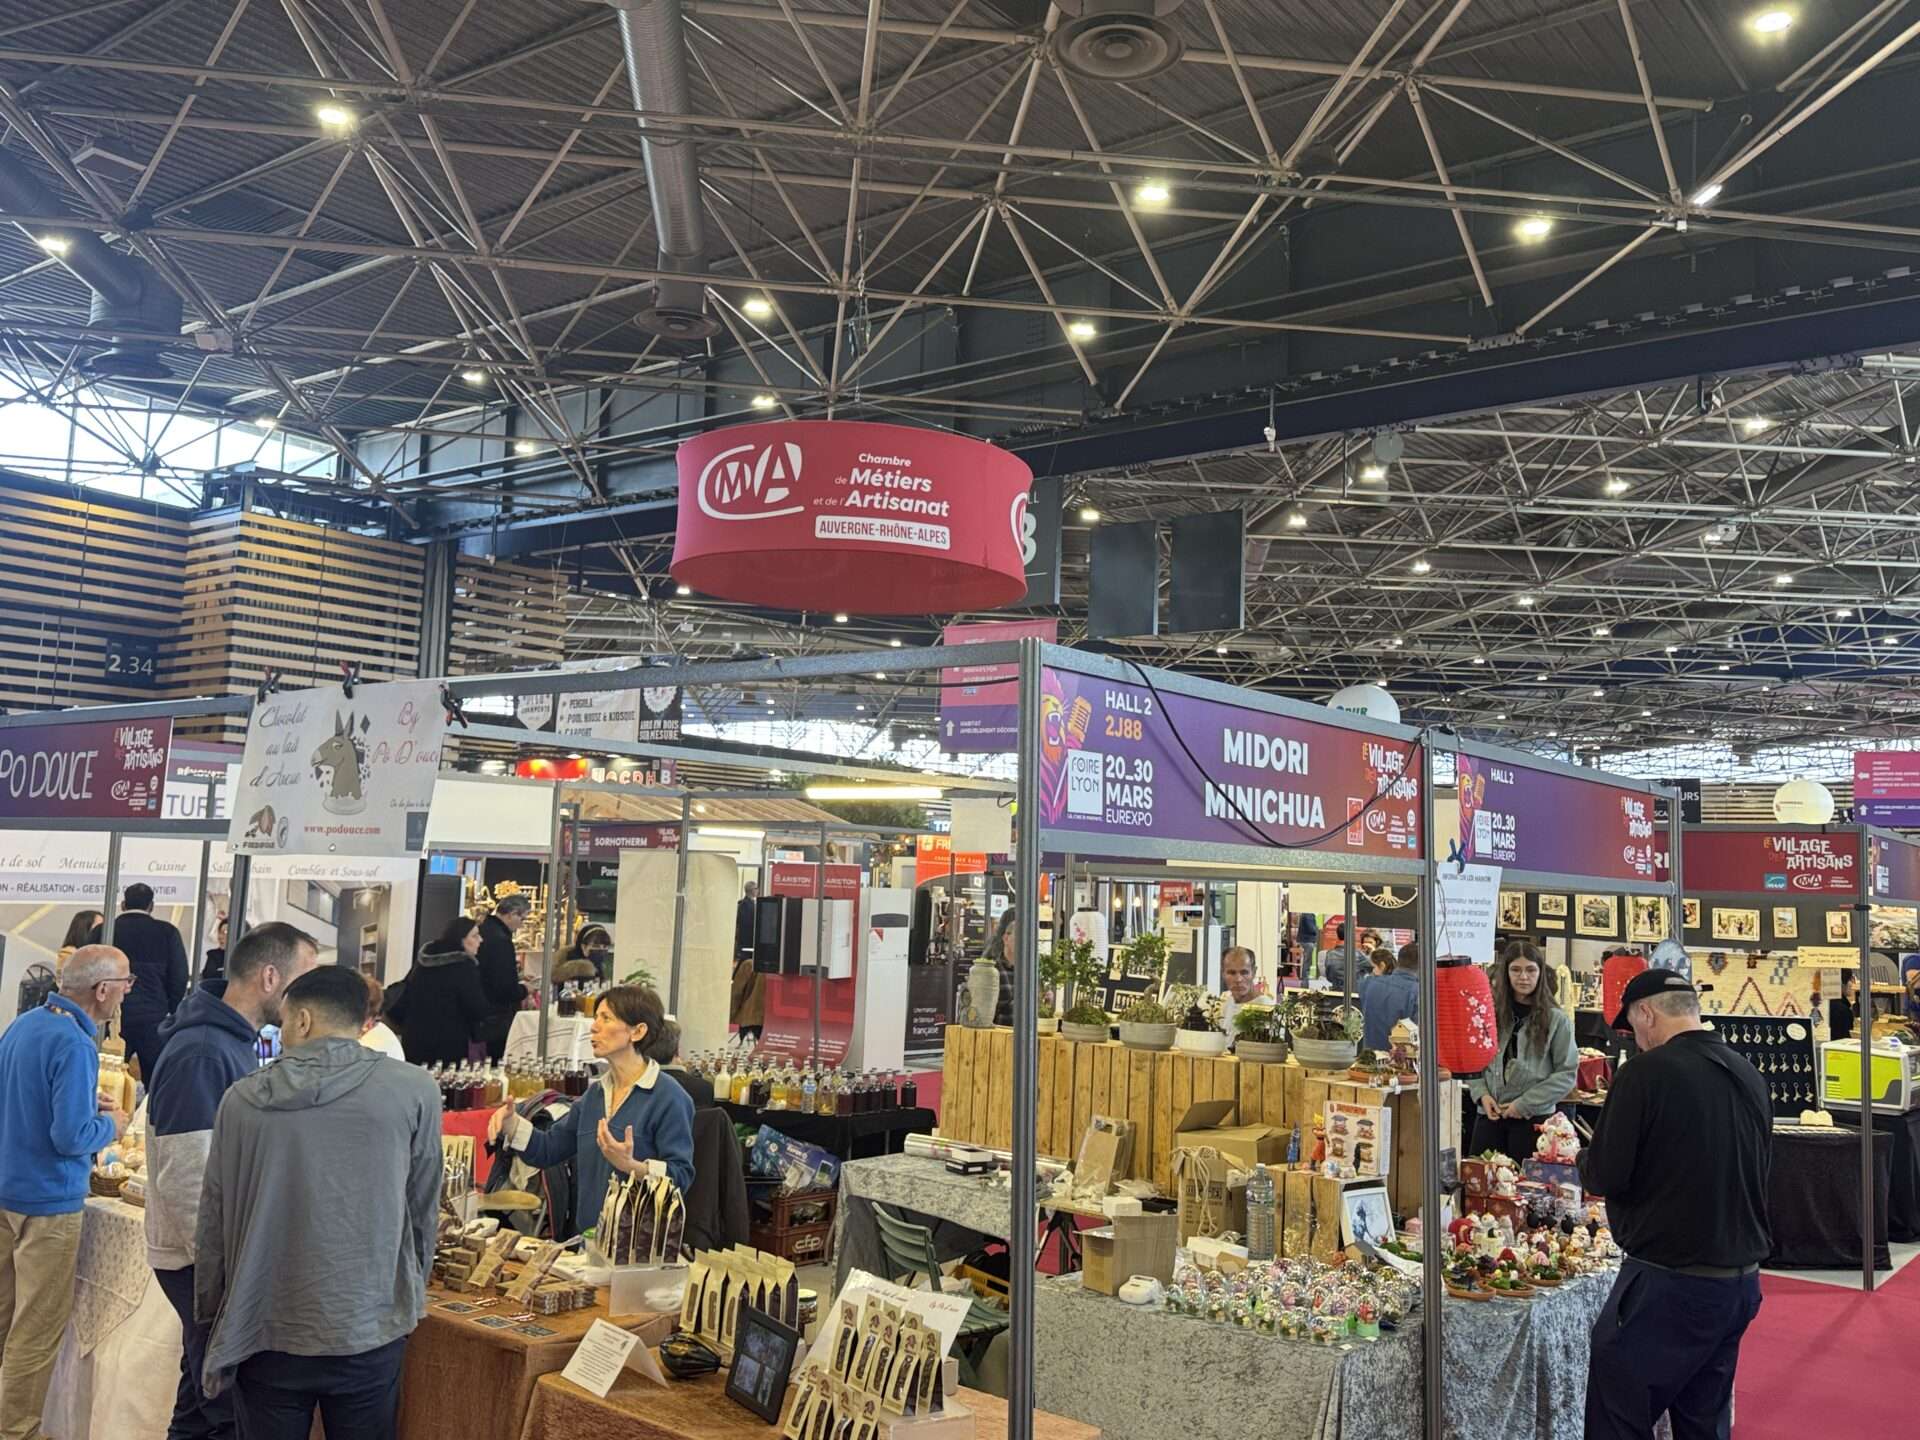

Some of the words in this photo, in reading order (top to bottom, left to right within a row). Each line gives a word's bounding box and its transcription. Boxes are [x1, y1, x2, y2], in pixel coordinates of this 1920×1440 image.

[858, 453, 912, 467] Chambre
[834, 476, 848, 485] de
[850, 467, 932, 493] Métiers
[813, 498, 823, 506] et
[825, 497, 837, 506] de
[819, 520, 947, 545] AUVERGNE-RHÔNE-ALPES
[108, 654, 153, 676] 2.34
[1105, 689, 1142, 714] HALL
[1144, 698, 1153, 715] 2
[650, 730, 680, 741] MESURE
[1105, 714, 1143, 741] 2J88
[120, 726, 154, 750] VILLAGE
[1223, 728, 1309, 775] MIDORI
[1368, 743, 1405, 774] VILLAGE
[1071, 756, 1100, 775] FOIRE
[1105, 754, 1153, 784] 20_30
[29, 751, 98, 800] DOUCE
[1071, 776, 1099, 793] LYON
[1491, 768, 1507, 784] HALL
[1508, 772, 1514, 785] 2
[1105, 781, 1153, 810] MARS
[1377, 773, 1418, 801] ARTISANS
[1204, 781, 1325, 830] MINICHUA
[1105, 808, 1153, 827] EUREXPO
[304, 825, 382, 837] www.podouce.com
[1492, 831, 1516, 850] MARS
[594, 836, 648, 847] SORHOTHERM
[1772, 836, 1833, 855] VILLAGE
[148, 860, 187, 873] Cuisine
[1786, 854, 1853, 871] ARTISANS
[16, 883, 75, 894] RÉALISATION
[782, 876, 812, 884] ARISTON
[826, 878, 857, 886] ARISTON
